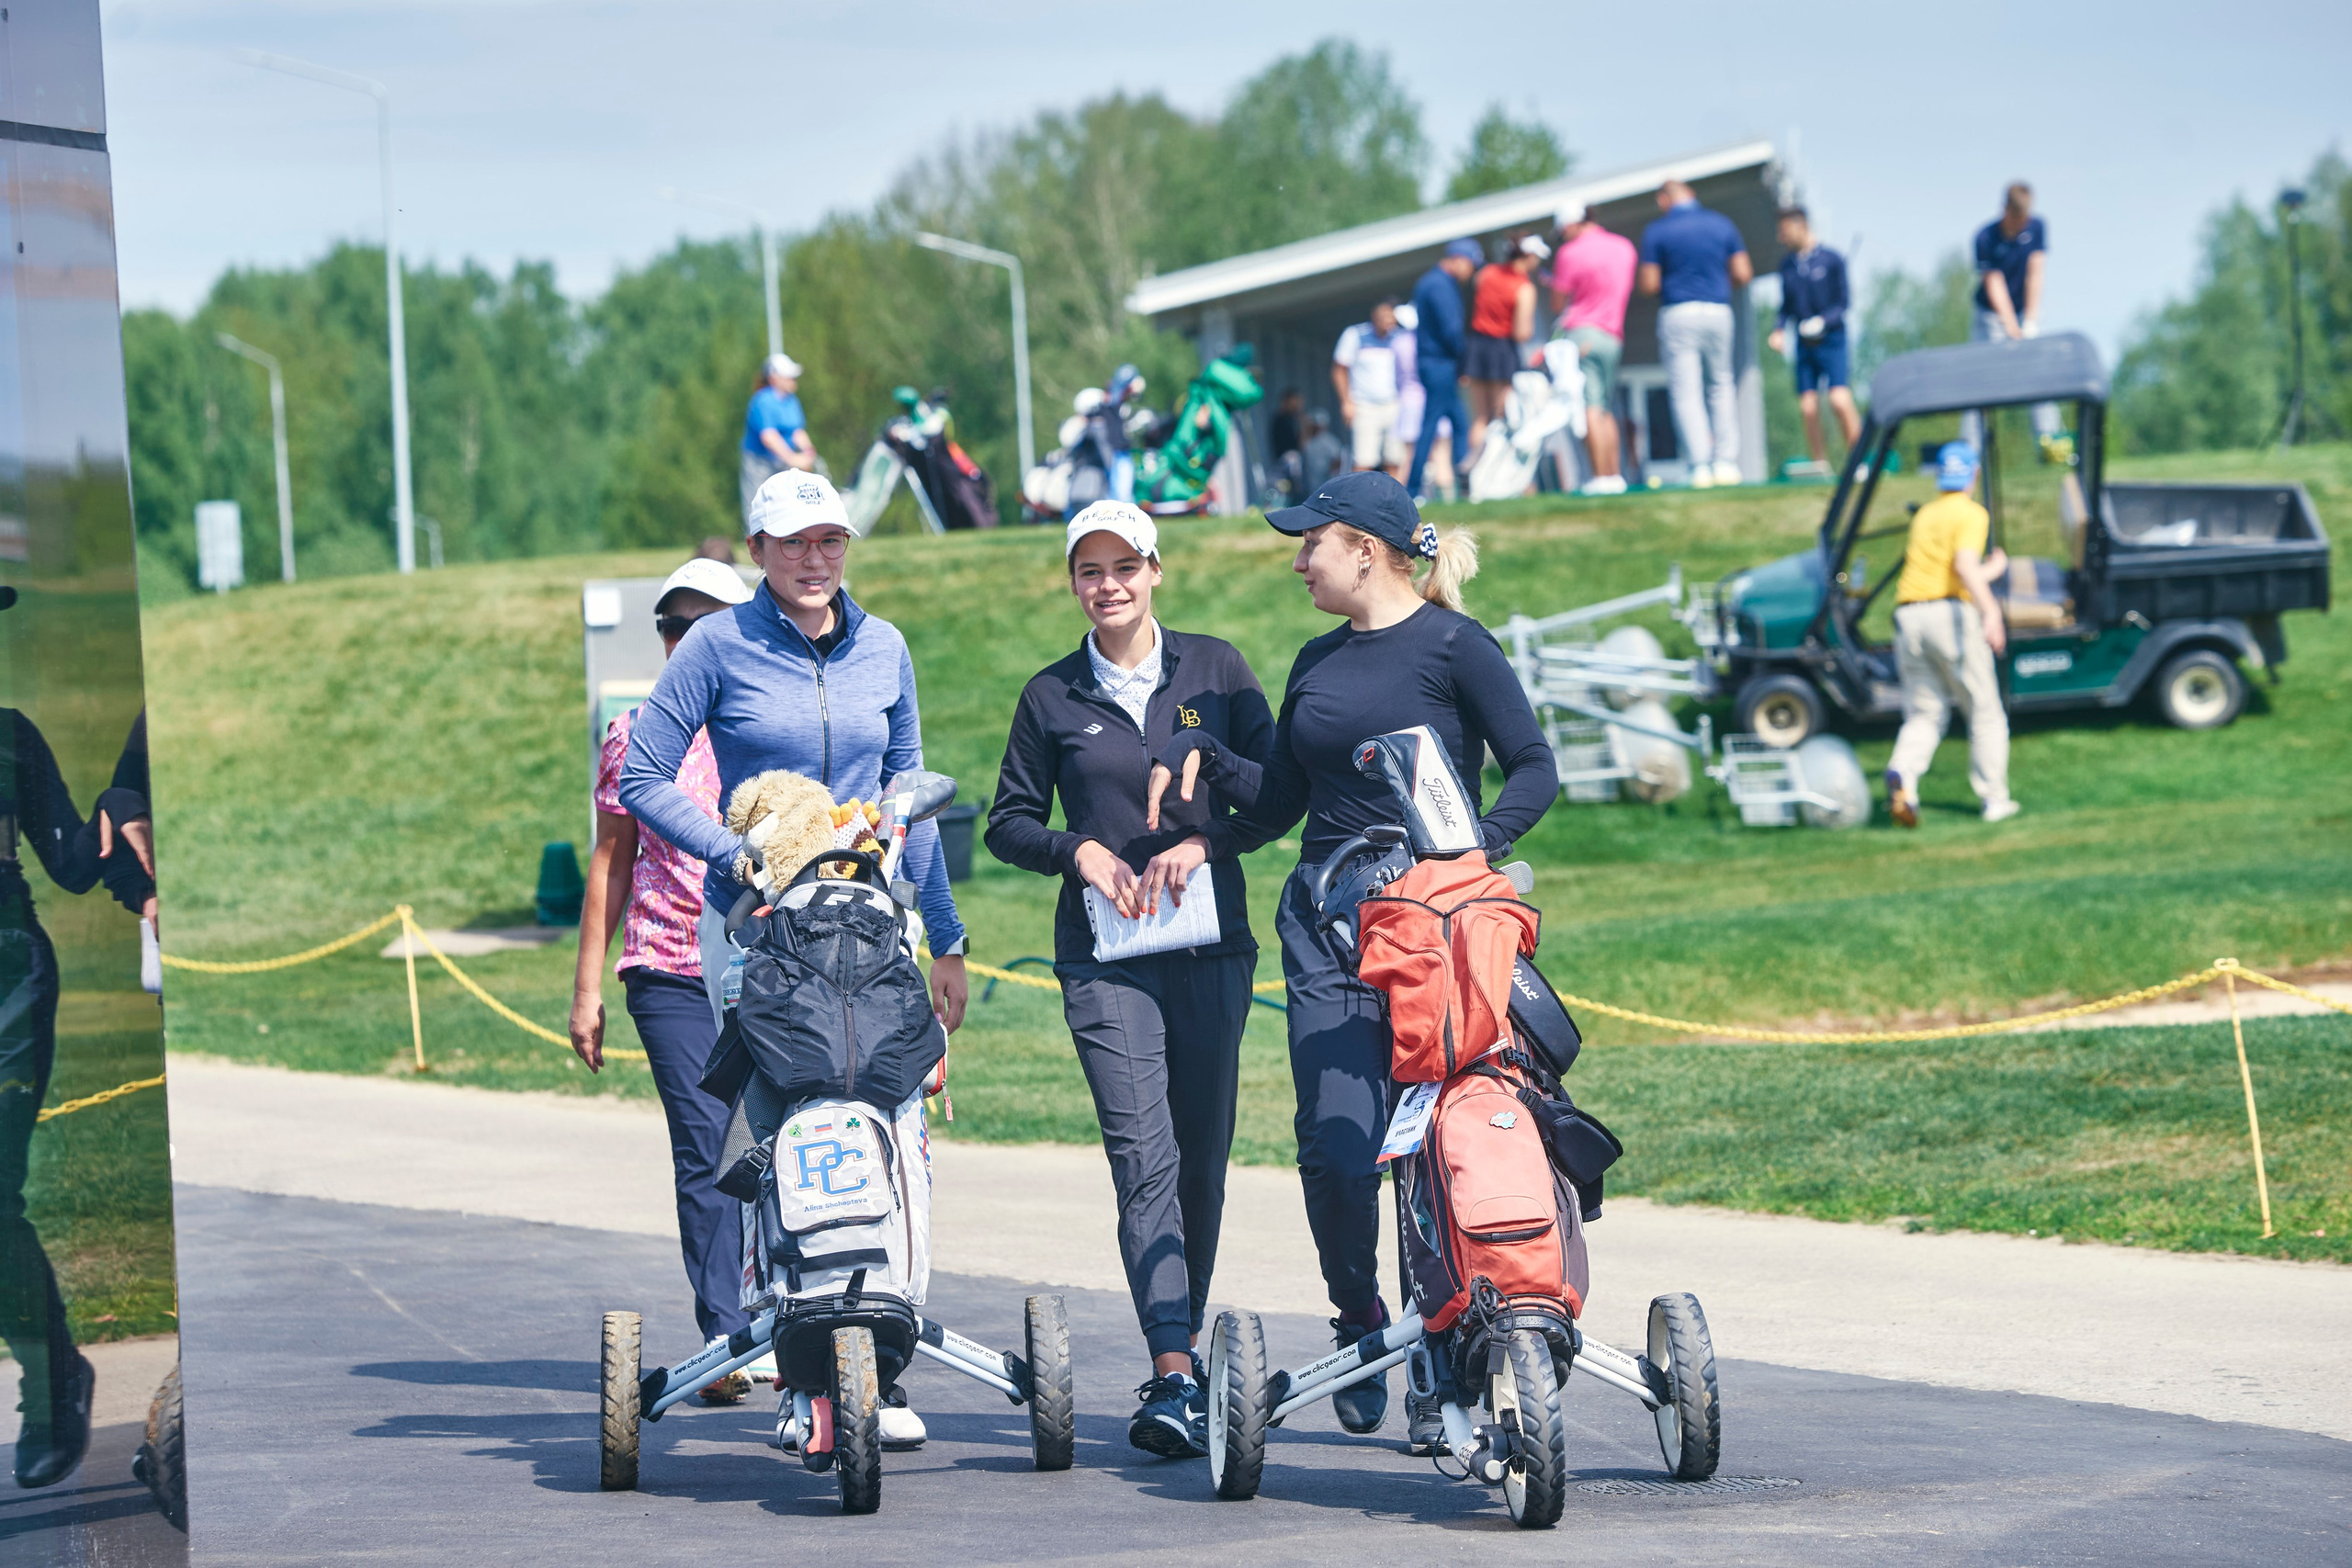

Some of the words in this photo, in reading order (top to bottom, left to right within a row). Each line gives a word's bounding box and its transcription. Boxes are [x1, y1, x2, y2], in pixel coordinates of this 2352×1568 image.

[1421, 777, 1457, 829] Titleist
[804, 1204, 823, 1213] Alina
[673, 1344, 727, 1375] www.clicgear.com
[1297, 1348, 1357, 1380] www.clicgear.com
